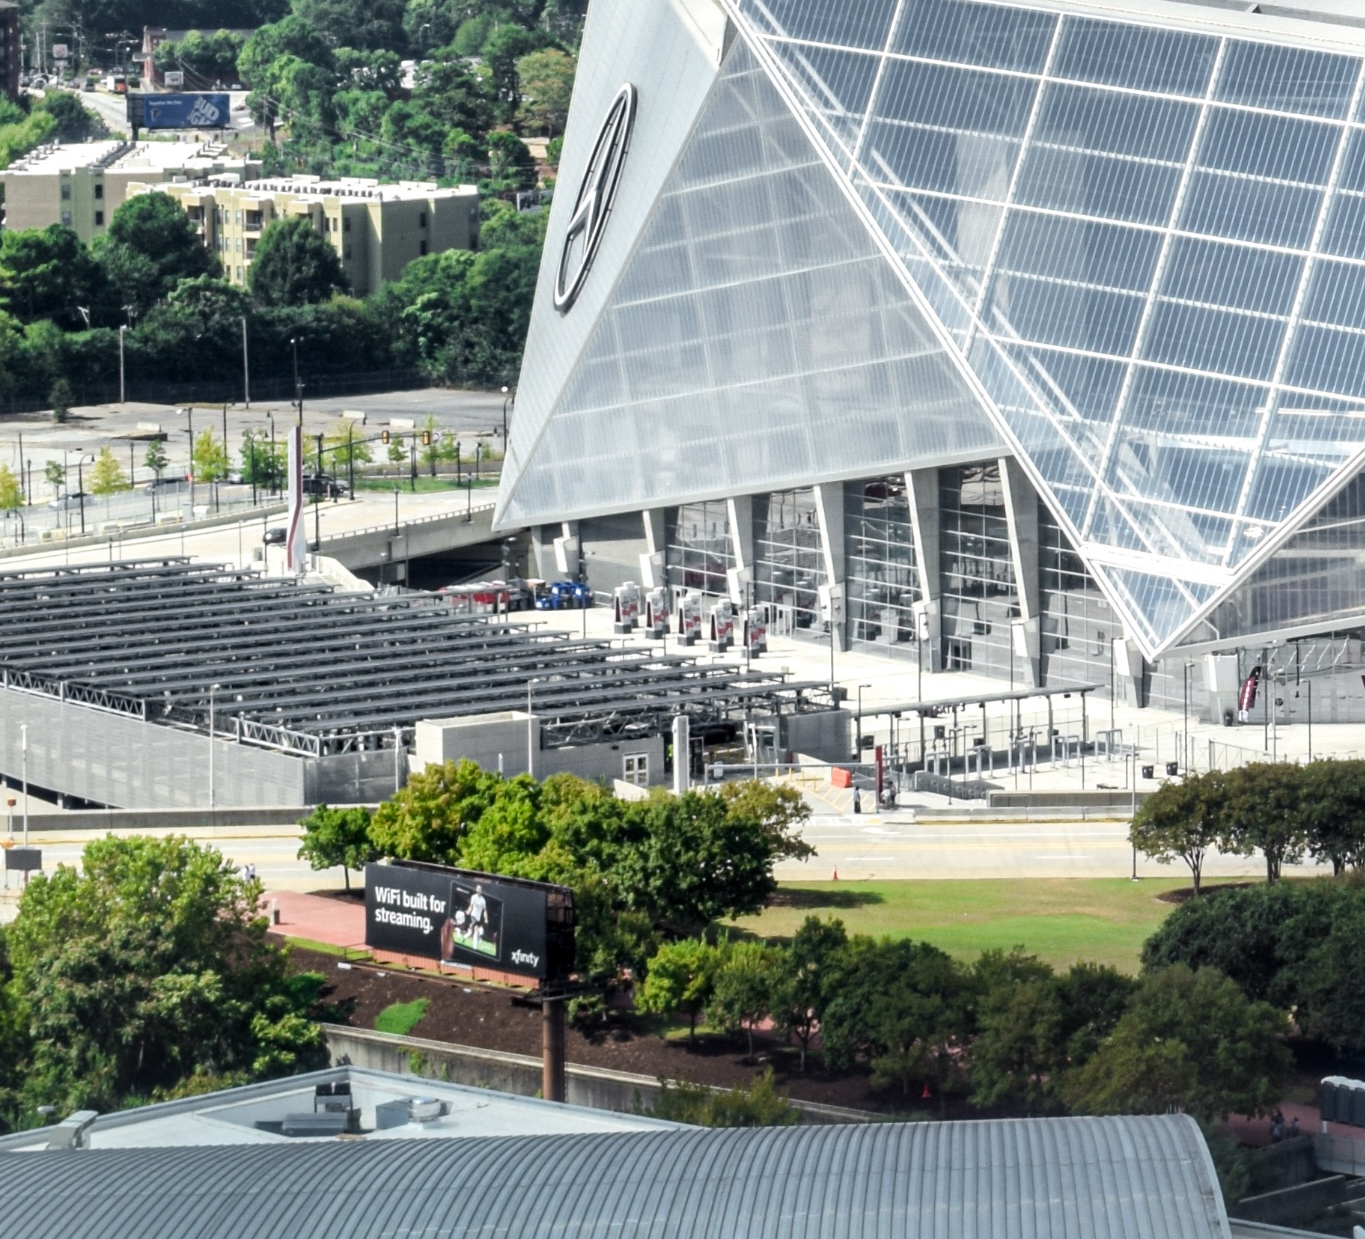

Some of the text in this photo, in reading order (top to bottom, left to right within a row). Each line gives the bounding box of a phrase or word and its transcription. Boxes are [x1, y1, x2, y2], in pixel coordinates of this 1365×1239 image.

[375, 885, 446, 913] WiFi built for
[375, 907, 434, 934] streaming.
[511, 949, 539, 968] xfinity
